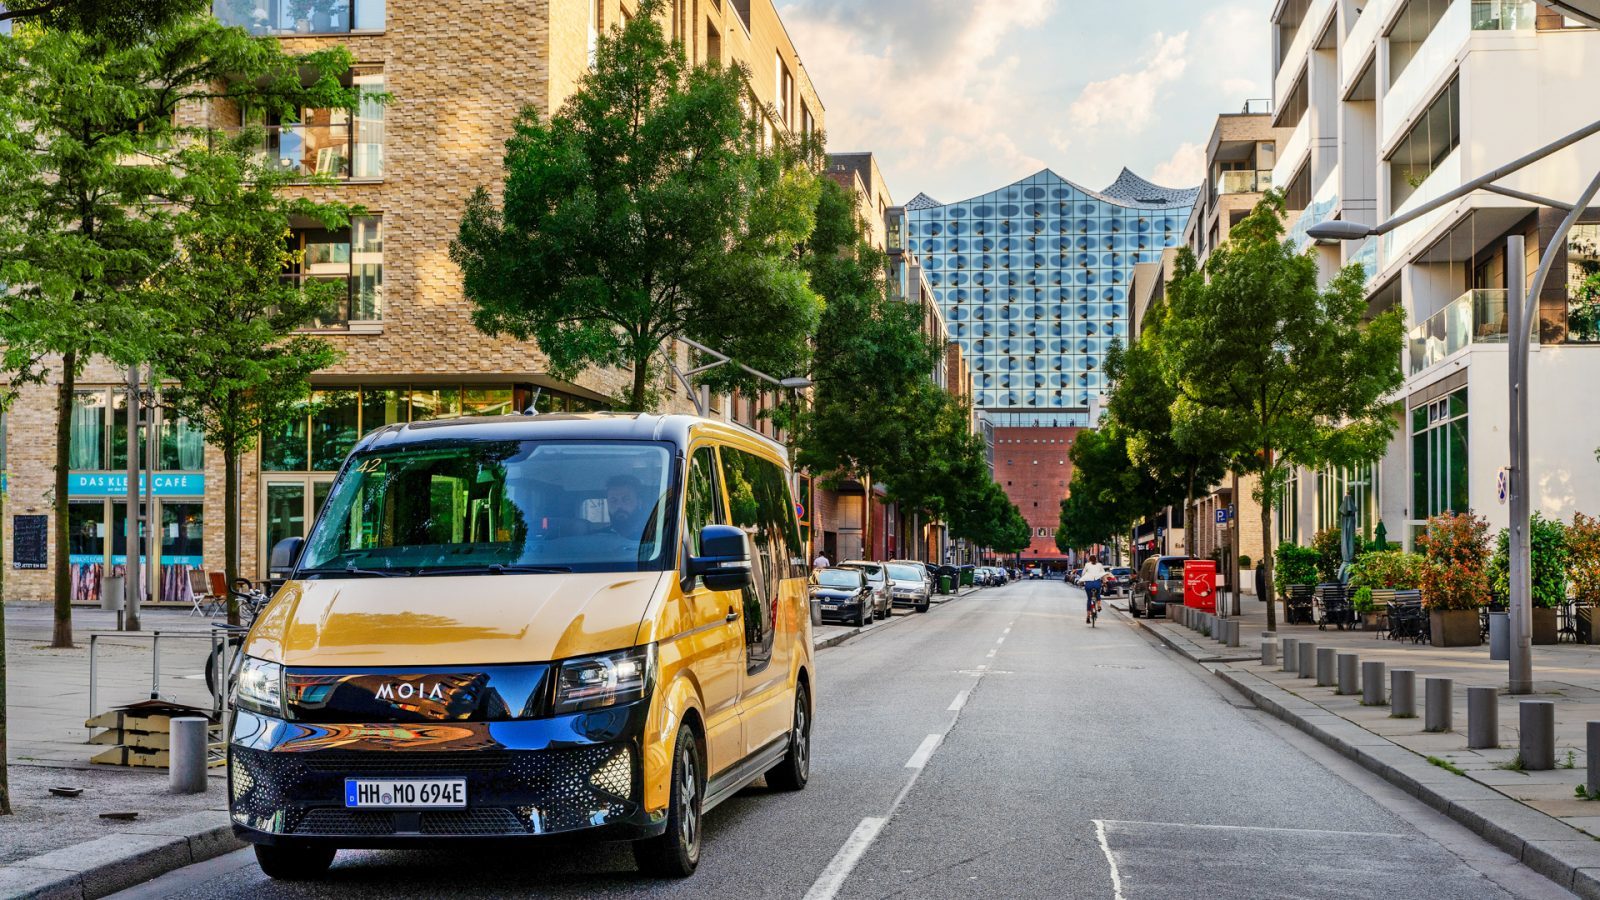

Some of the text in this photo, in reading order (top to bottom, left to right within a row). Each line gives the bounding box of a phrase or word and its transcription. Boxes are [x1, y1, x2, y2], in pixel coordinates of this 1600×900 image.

[355, 458, 382, 473] 42
[80, 477, 104, 486] DAS
[154, 475, 187, 487] CAFÉ
[1217, 510, 1224, 521] P
[374, 683, 443, 699] MOIA
[358, 783, 464, 803] HH MO 694E
